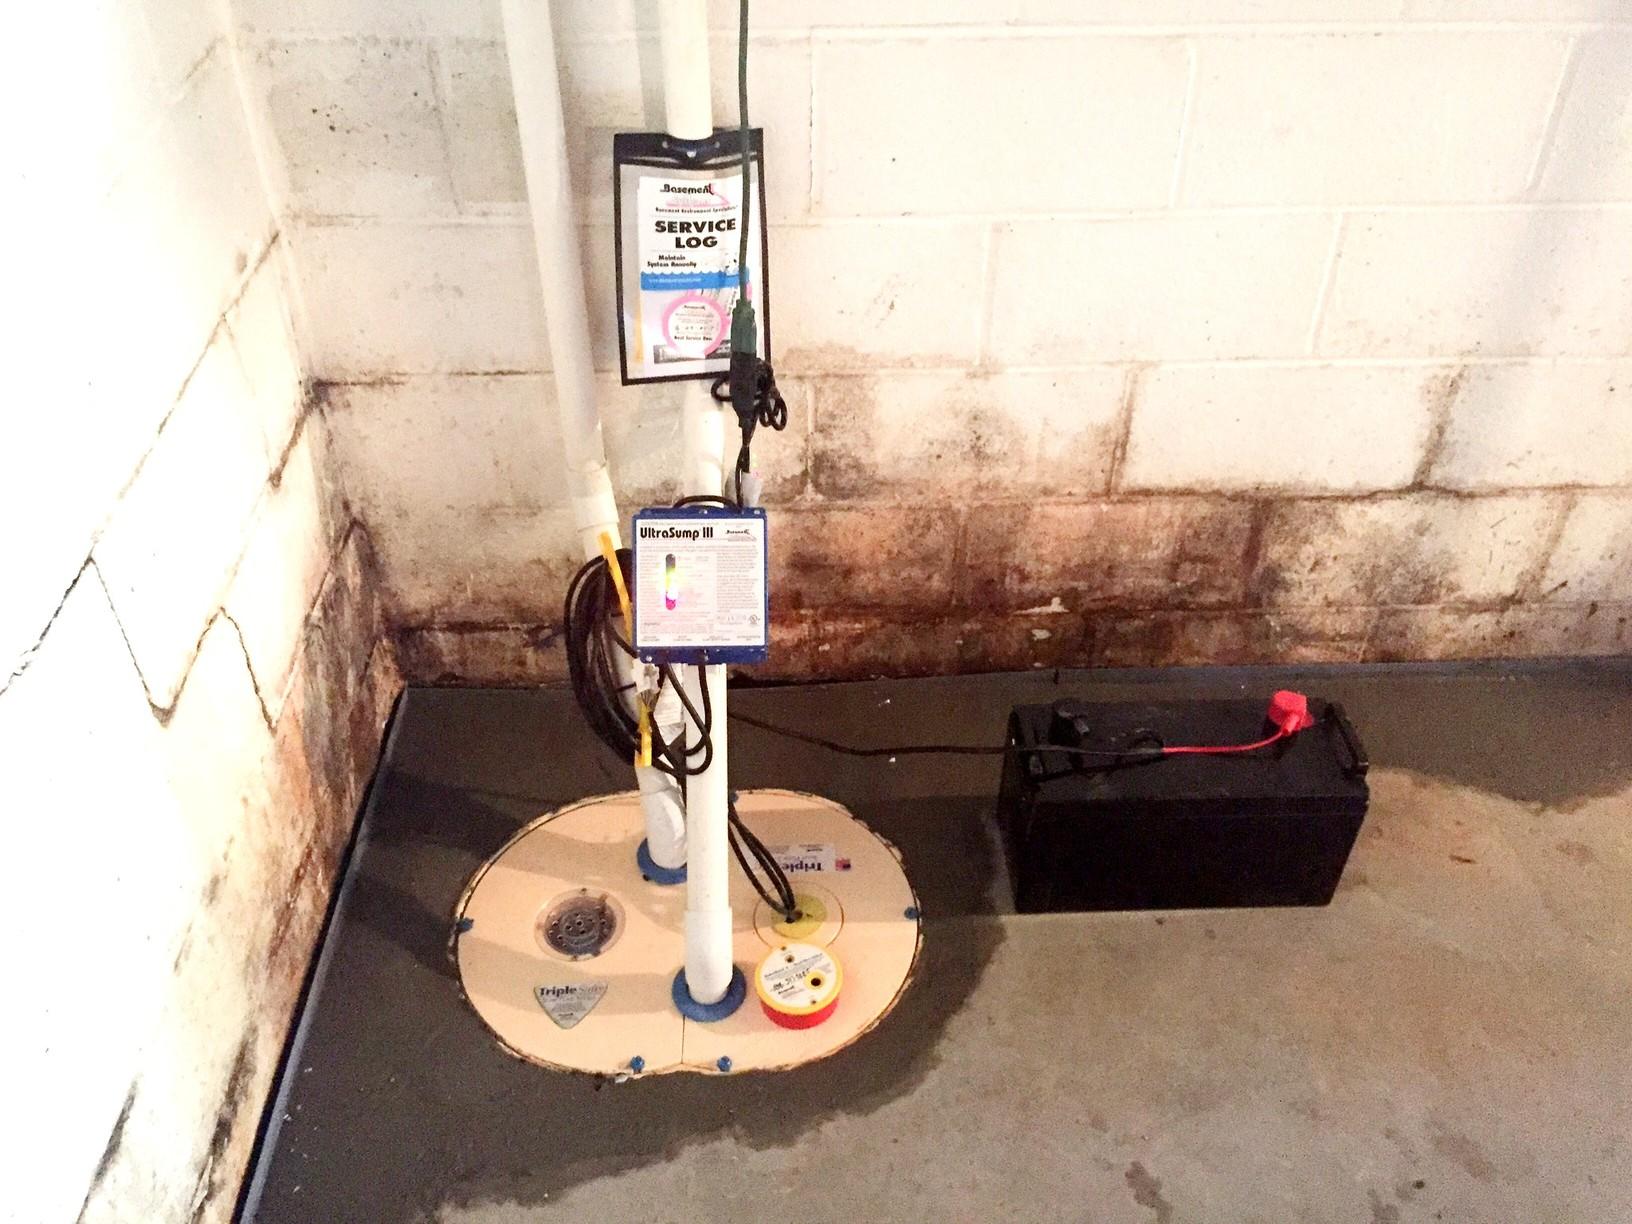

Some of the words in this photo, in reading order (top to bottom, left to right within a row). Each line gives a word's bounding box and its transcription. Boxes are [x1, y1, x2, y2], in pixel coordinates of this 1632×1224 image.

[655, 218, 737, 234] SERVICE
[675, 236, 718, 249] LOG
[640, 527, 700, 541] UltraSump
[702, 527, 714, 538] III
